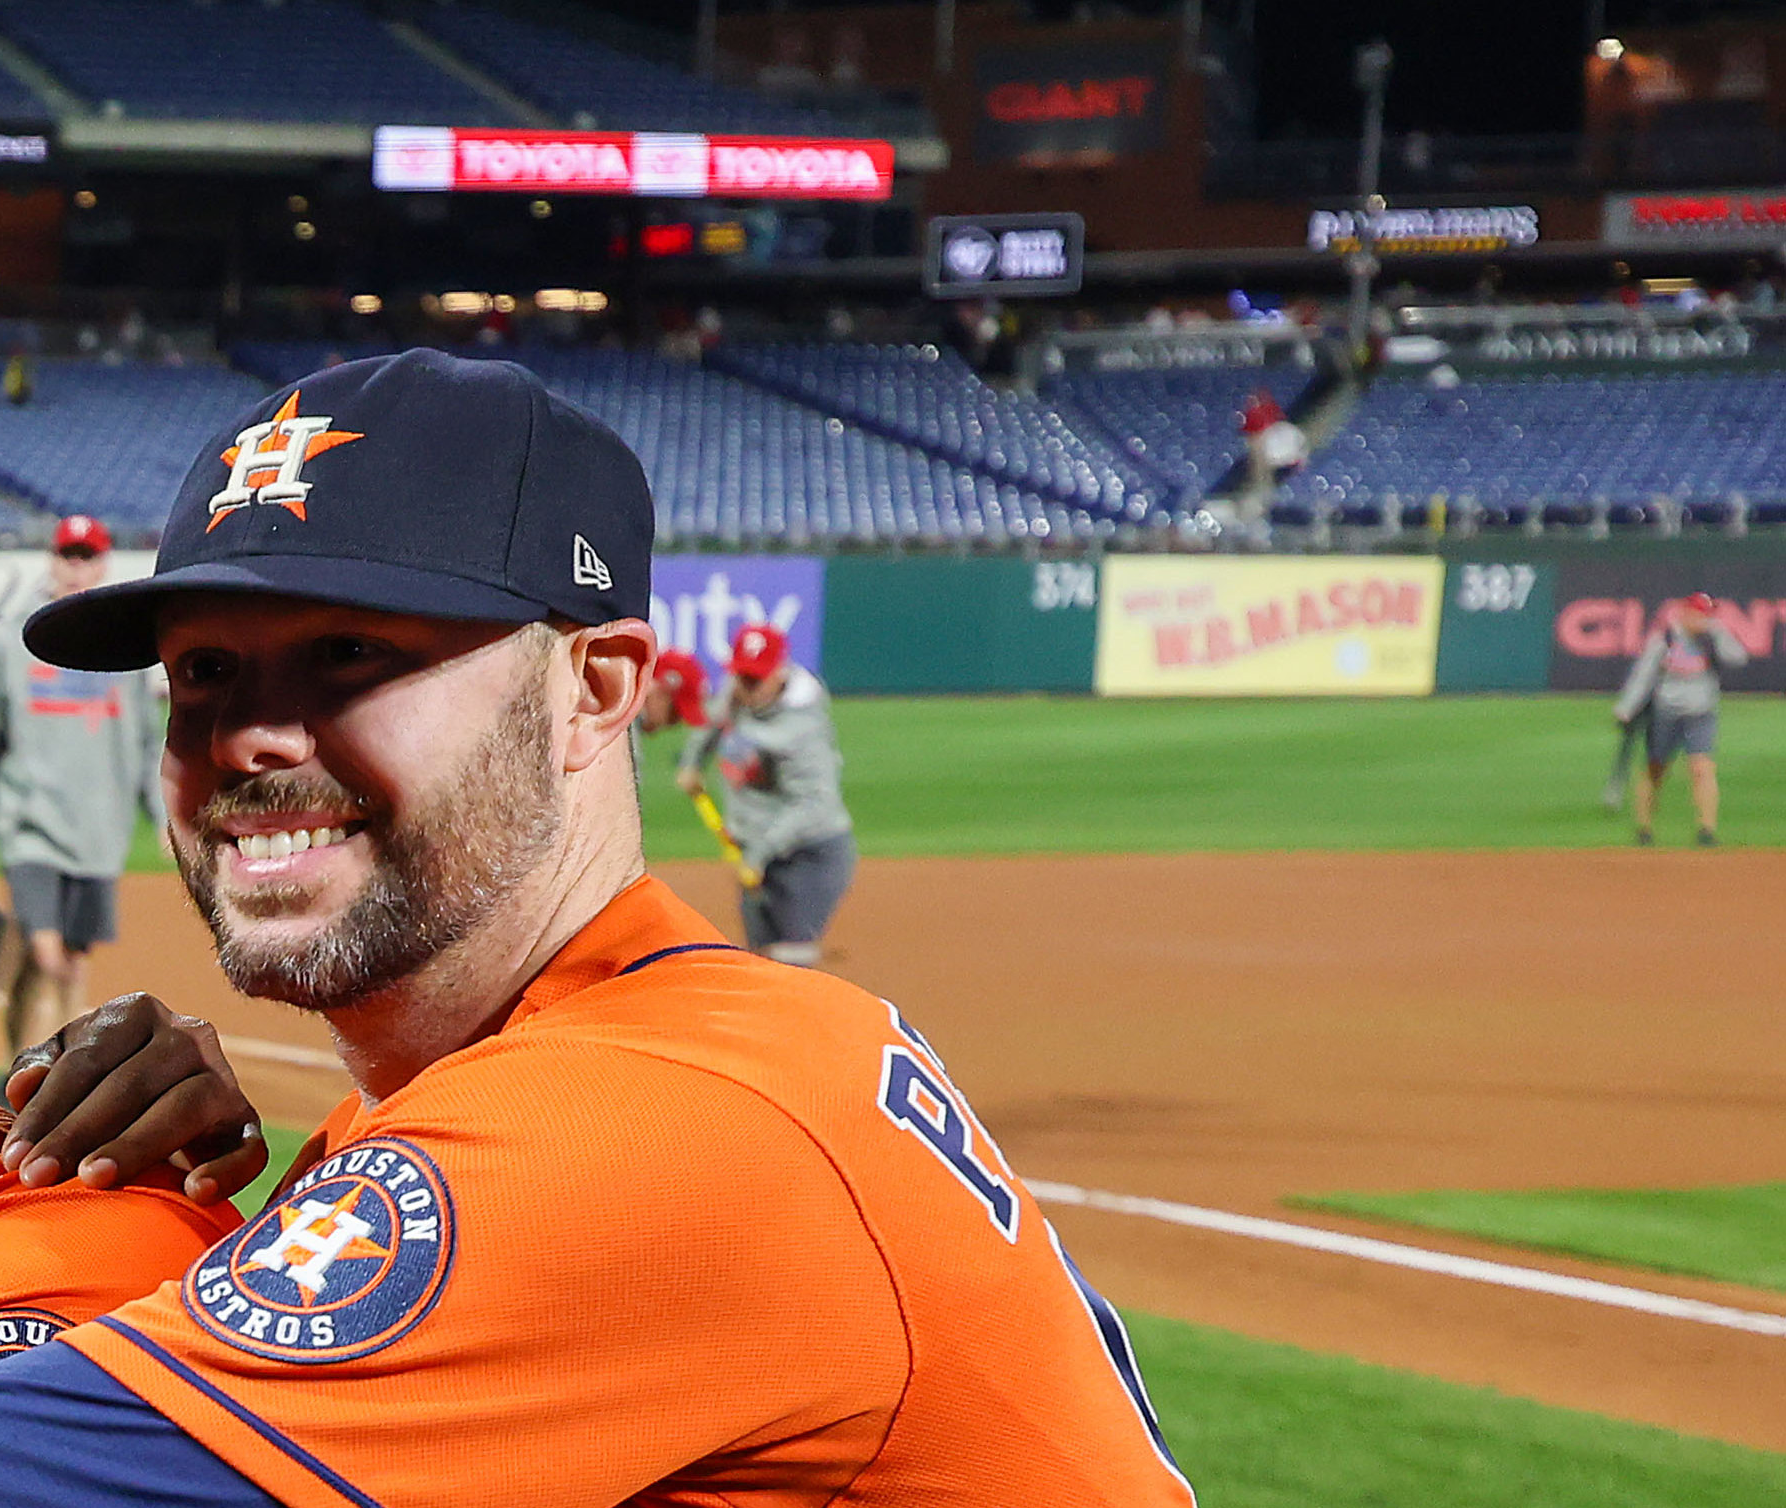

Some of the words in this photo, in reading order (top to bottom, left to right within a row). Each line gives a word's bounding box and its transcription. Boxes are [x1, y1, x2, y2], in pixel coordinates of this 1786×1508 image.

[460, 139, 630, 183] TOYOTA
[713, 145, 880, 190] TOYOTA
[207, 416, 334, 515] H
[1458, 563, 1537, 611] 387
[291, 1150, 439, 1244] HOUSTON
[248, 1197, 373, 1296] H
[194, 1263, 336, 1349] ASTROS
